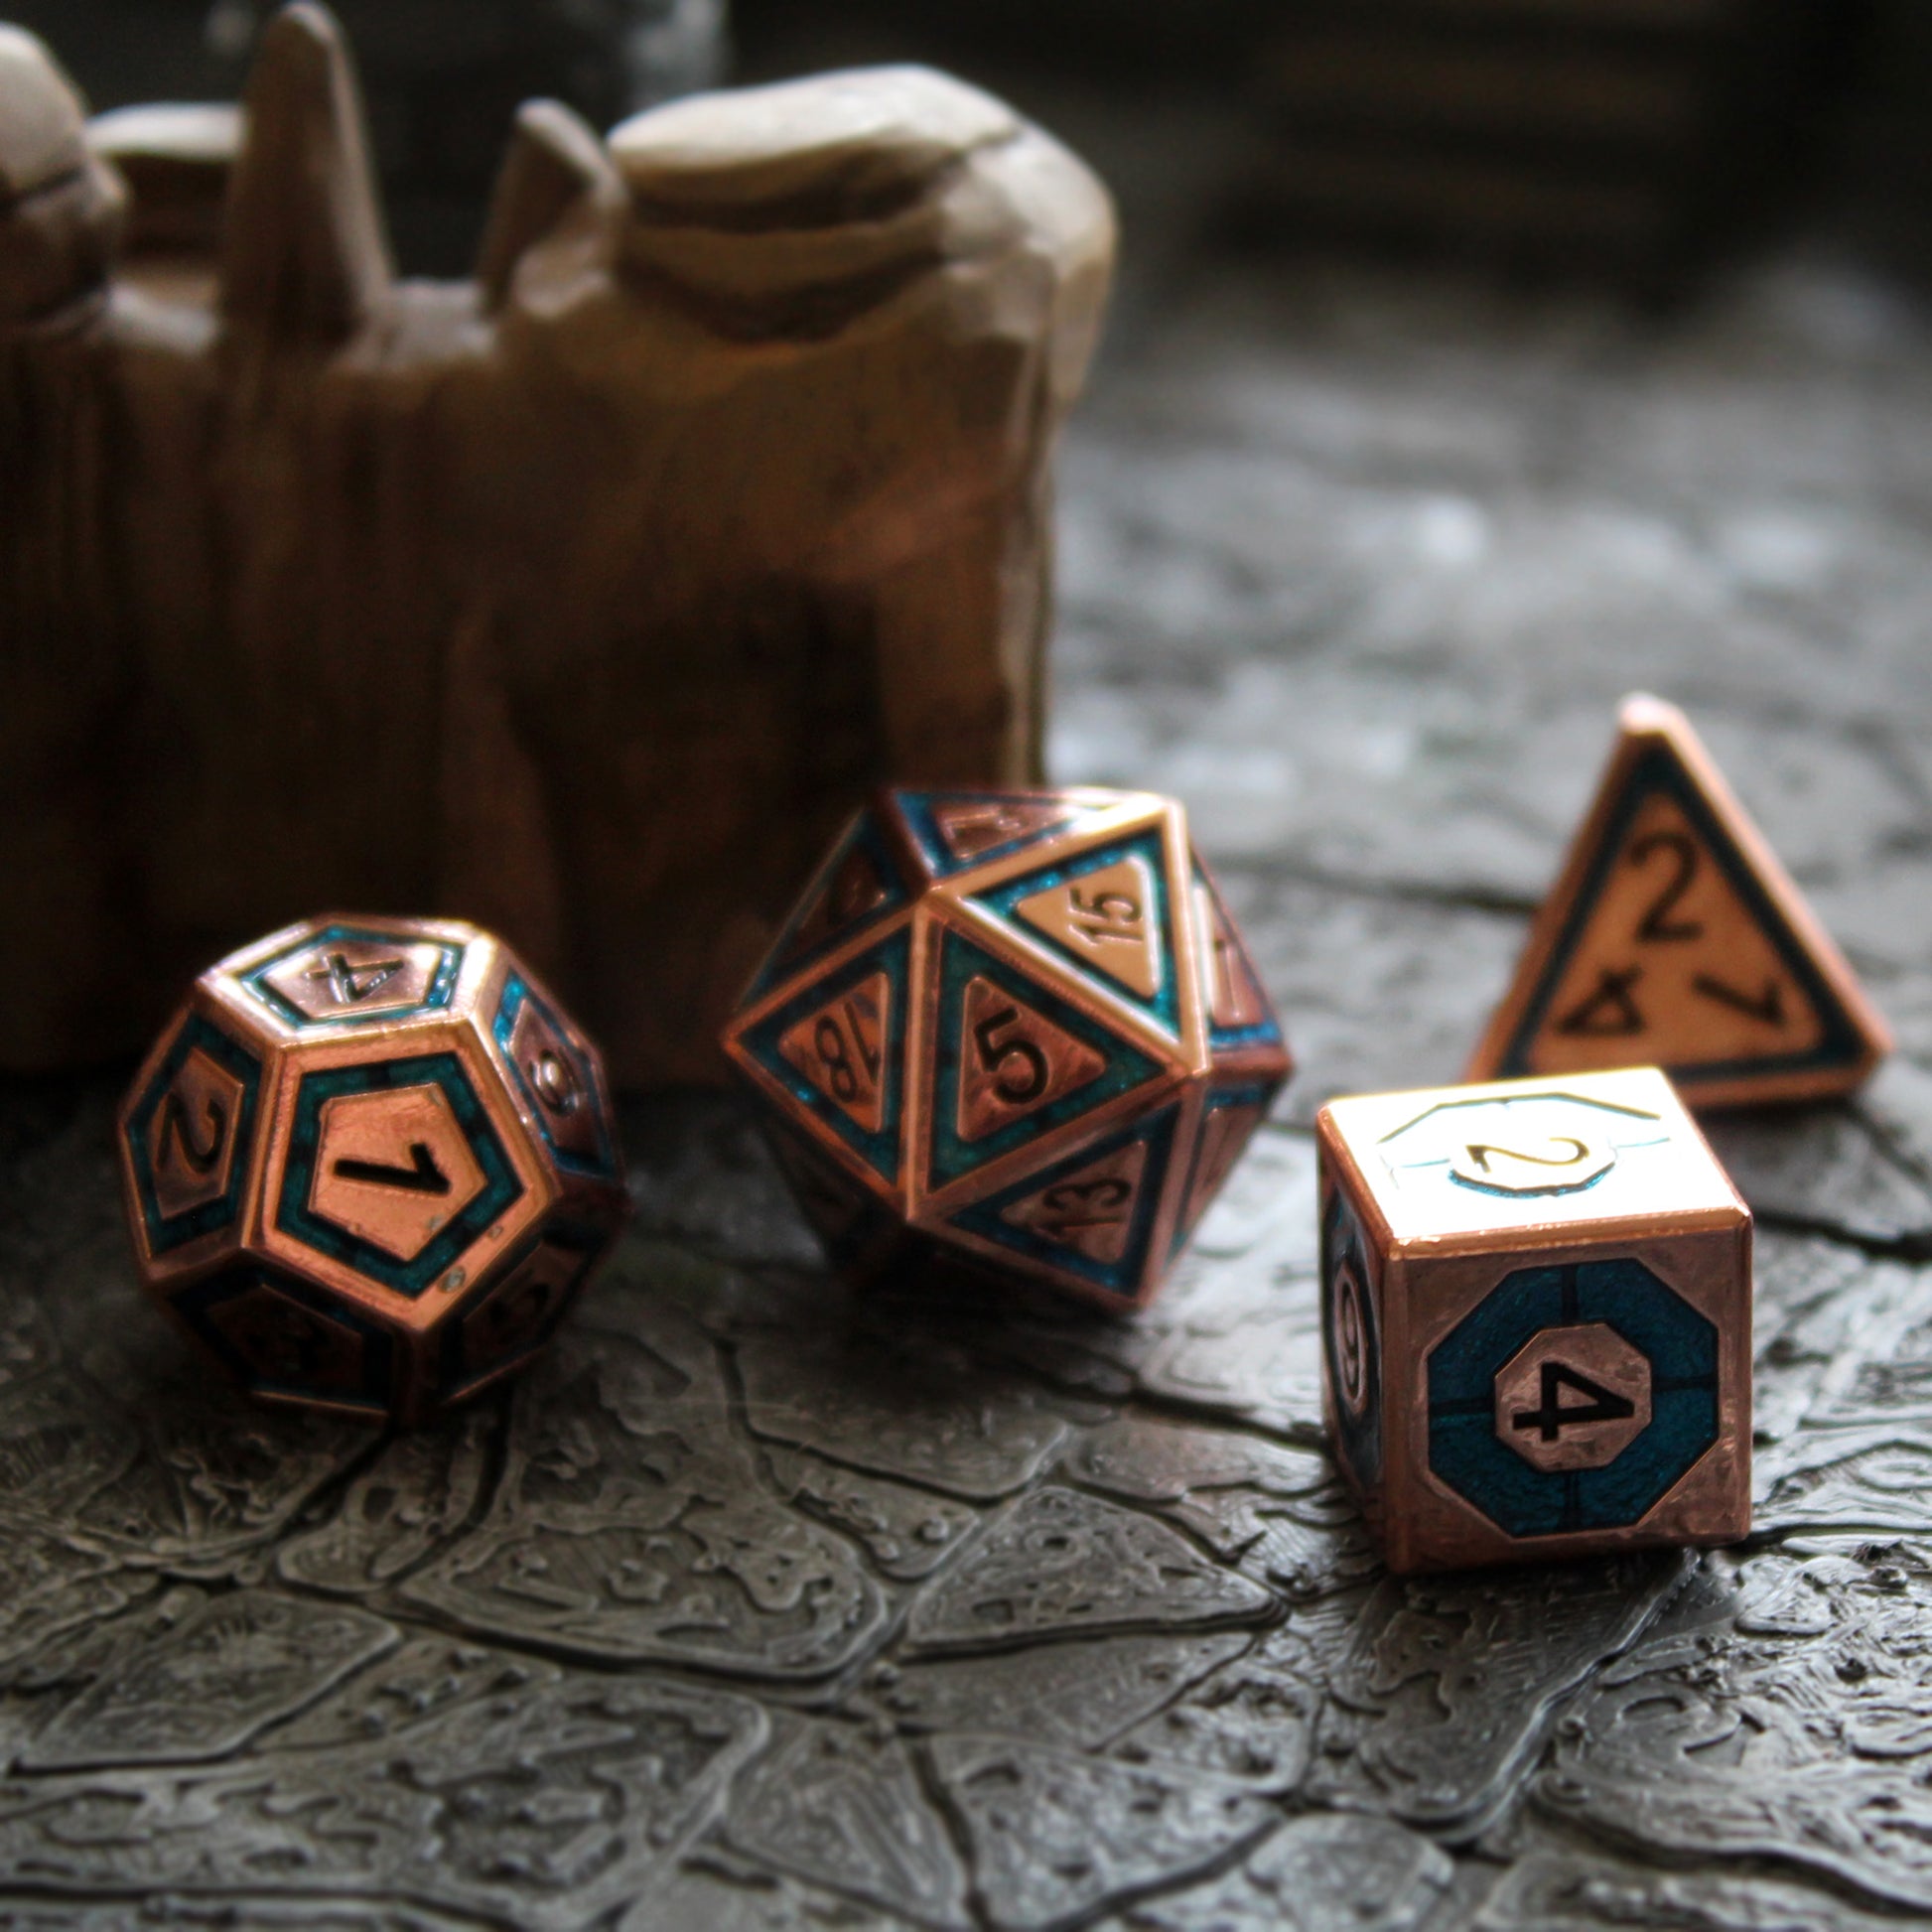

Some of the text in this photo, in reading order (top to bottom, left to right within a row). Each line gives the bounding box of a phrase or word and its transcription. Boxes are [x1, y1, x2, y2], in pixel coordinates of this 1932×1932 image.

[1066, 888, 1143, 947] 15
[1630, 830, 1705, 944] 2
[304, 951, 405, 1003] 4
[1557, 964, 1647, 1036] 4
[1692, 972, 1784, 1029] 1
[814, 1002, 882, 1103] 18
[973, 1006, 1050, 1105] 5
[155, 1094, 225, 1174] 2
[1465, 1137, 1589, 1173] 2
[334, 1143, 453, 1196] 1
[1040, 1176, 1132, 1237] 13
[1512, 1360, 1635, 1444] 4
